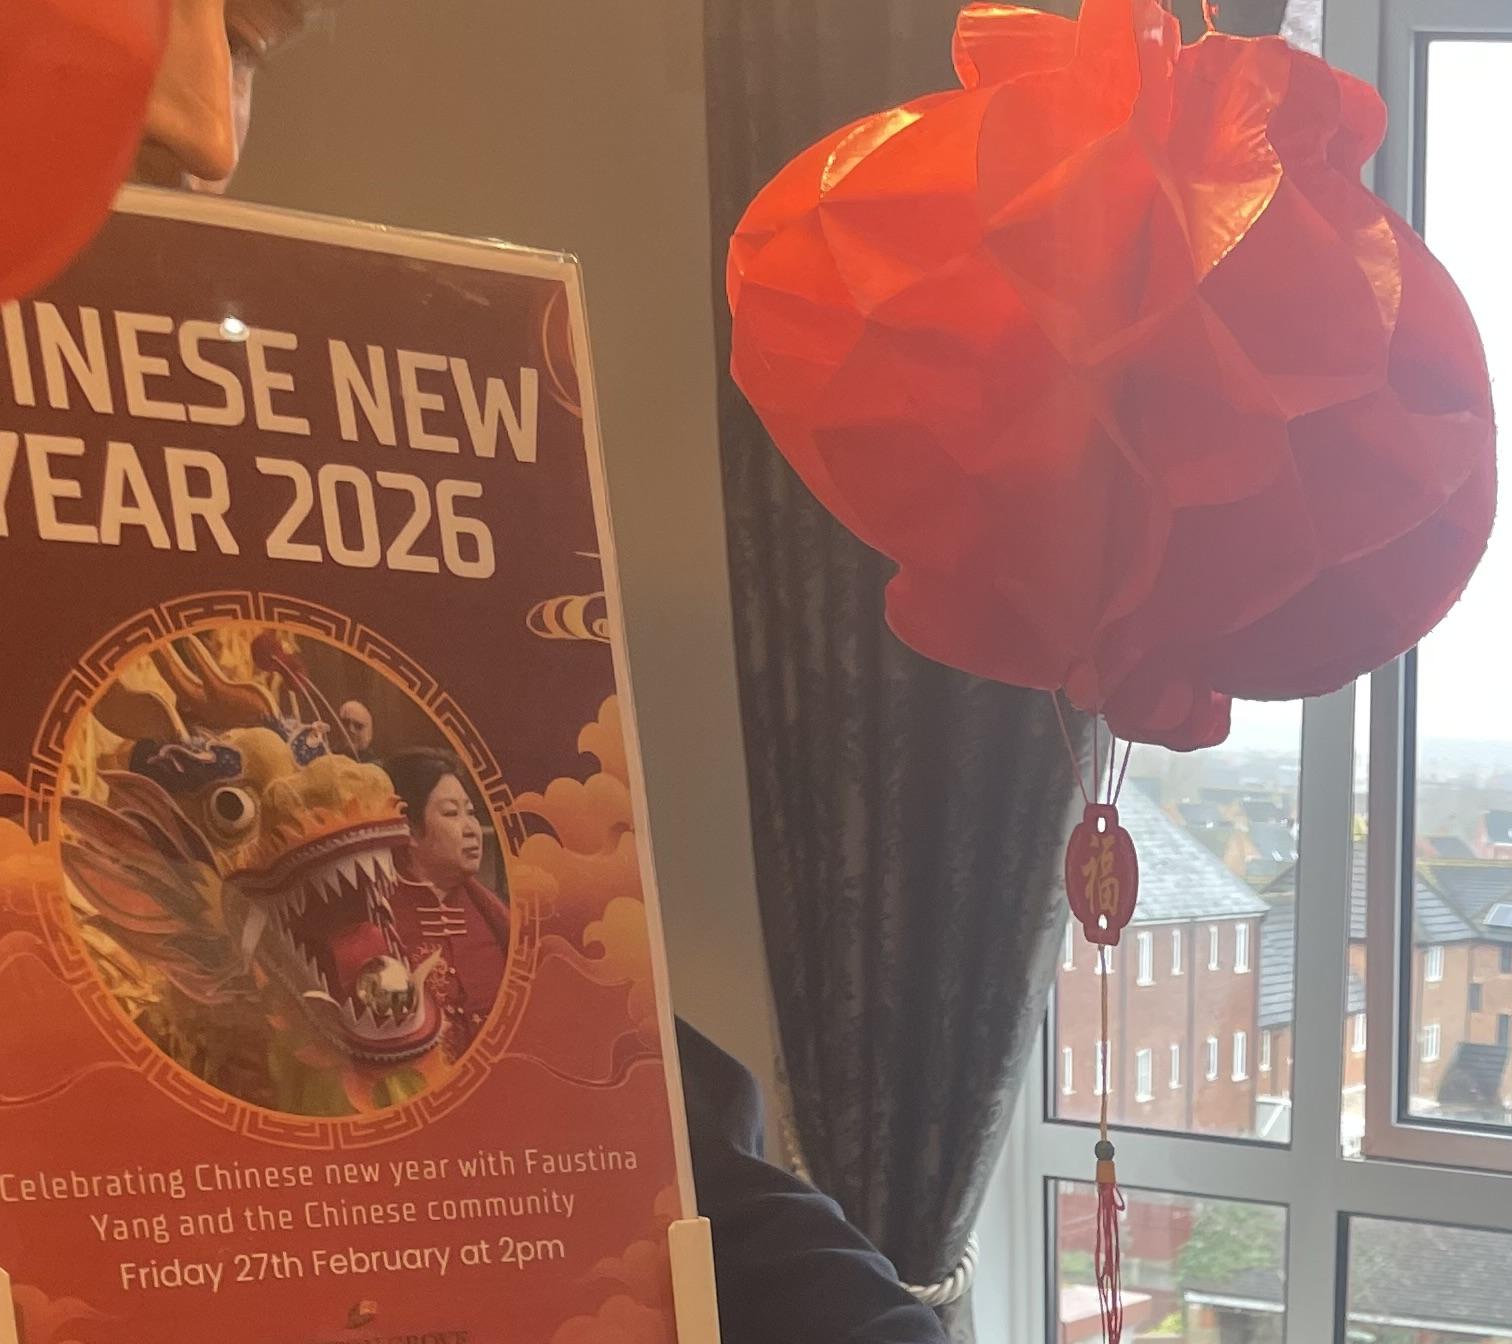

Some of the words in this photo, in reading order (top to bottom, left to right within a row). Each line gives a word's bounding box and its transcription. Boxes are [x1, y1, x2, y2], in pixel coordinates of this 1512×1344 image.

[0, 300, 310, 436] INESE
[329, 340, 540, 463] NEW
[255, 457, 496, 579] 2026
[0, 1166, 186, 1202] Celebrating
[194, 1161, 314, 1193] Chinese
[325, 1161, 380, 1185] new
[391, 1157, 448, 1186] year
[458, 1150, 516, 1178] with
[525, 1145, 638, 1175] Faustina
[90, 1213, 170, 1243] Yang
[179, 1208, 234, 1235] and
[244, 1204, 293, 1232] the
[305, 1197, 417, 1229] Chinese
[427, 1190, 576, 1220] community
[119, 1258, 224, 1292] Friday
[234, 1251, 303, 1283] 27th
[312, 1242, 451, 1277] February
[460, 1239, 491, 1265] at
[499, 1235, 566, 1269] 2pm
